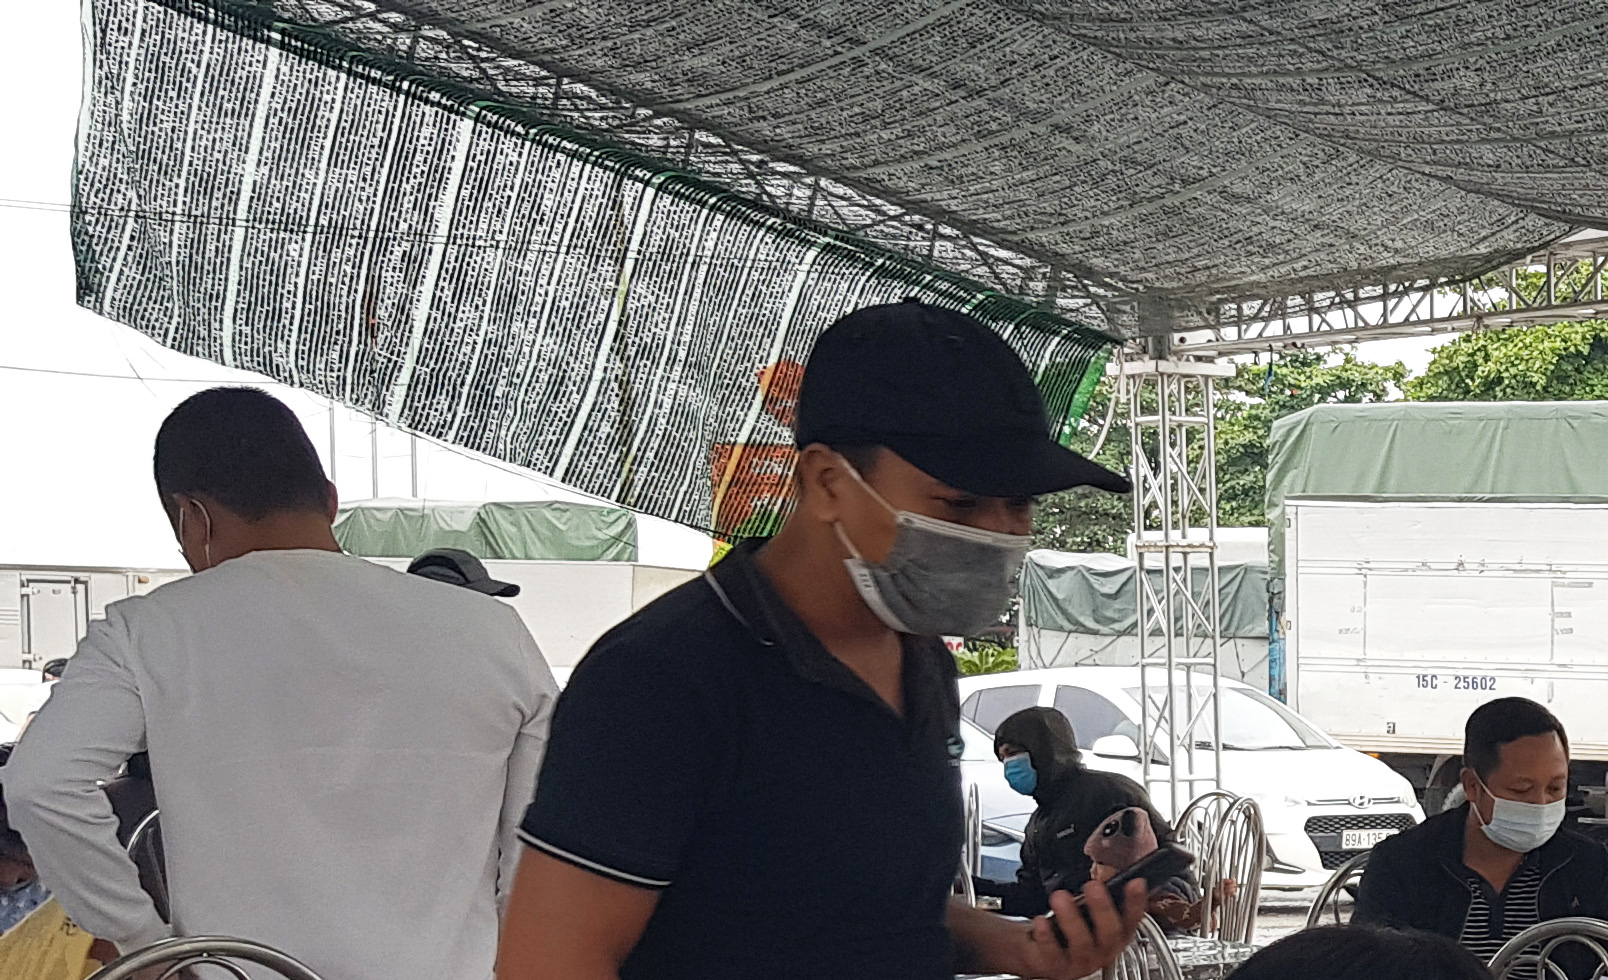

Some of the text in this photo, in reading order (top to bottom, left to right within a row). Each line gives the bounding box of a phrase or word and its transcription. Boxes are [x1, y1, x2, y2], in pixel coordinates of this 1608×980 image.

[1416, 674, 1438, 689] 15C
[1454, 676, 1496, 690] 25602
[1345, 832, 1395, 846] 89A-135
